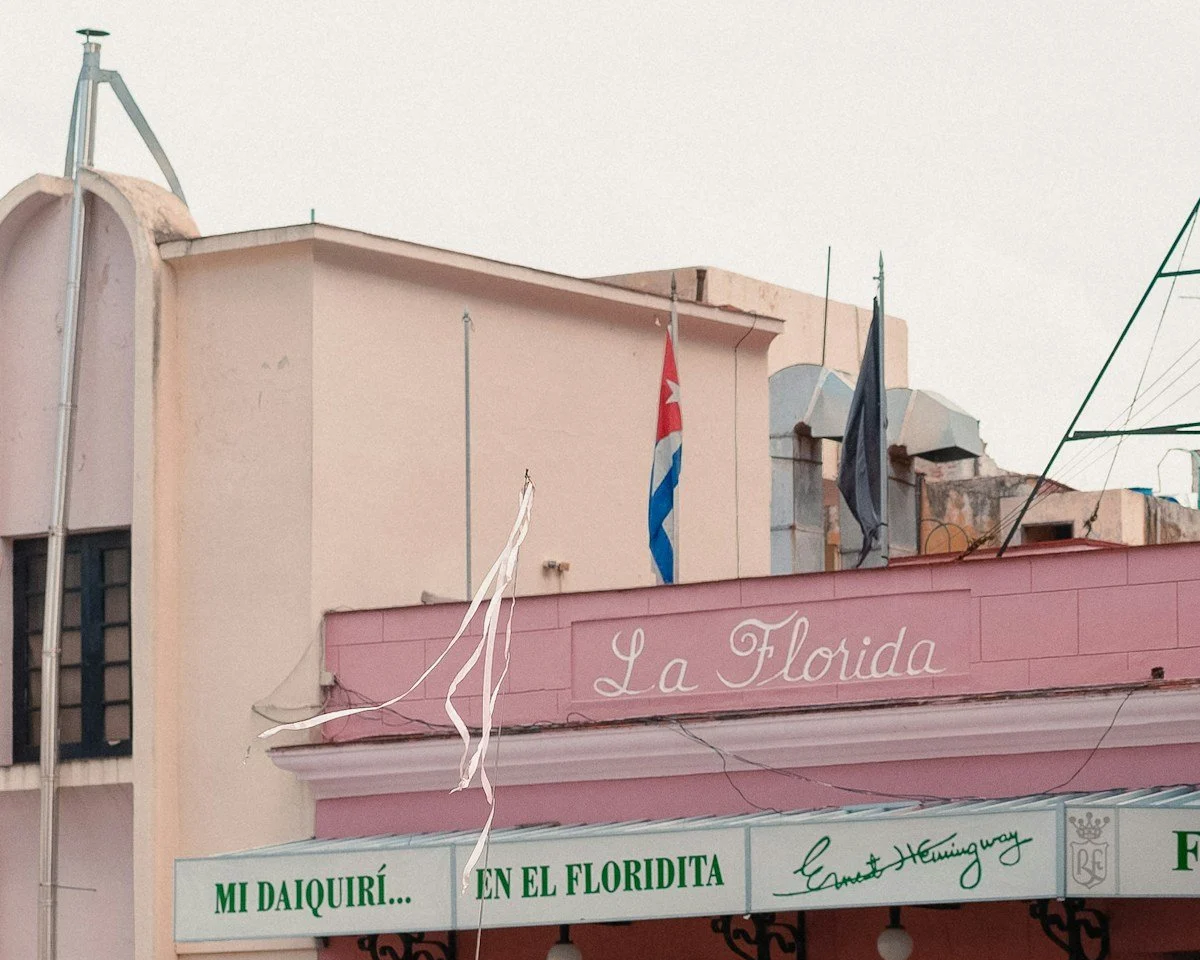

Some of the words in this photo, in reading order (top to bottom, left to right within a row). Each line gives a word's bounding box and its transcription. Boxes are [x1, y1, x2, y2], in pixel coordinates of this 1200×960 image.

[594, 628, 698, 697] La
[716, 611, 946, 689] Florida
[214, 881, 248, 913] MI
[256, 863, 411, 918] DAIQUIRÍ...
[476, 867, 512, 900] EN
[521, 865, 556, 898] EL
[565, 854, 725, 895] FLORIDITA
